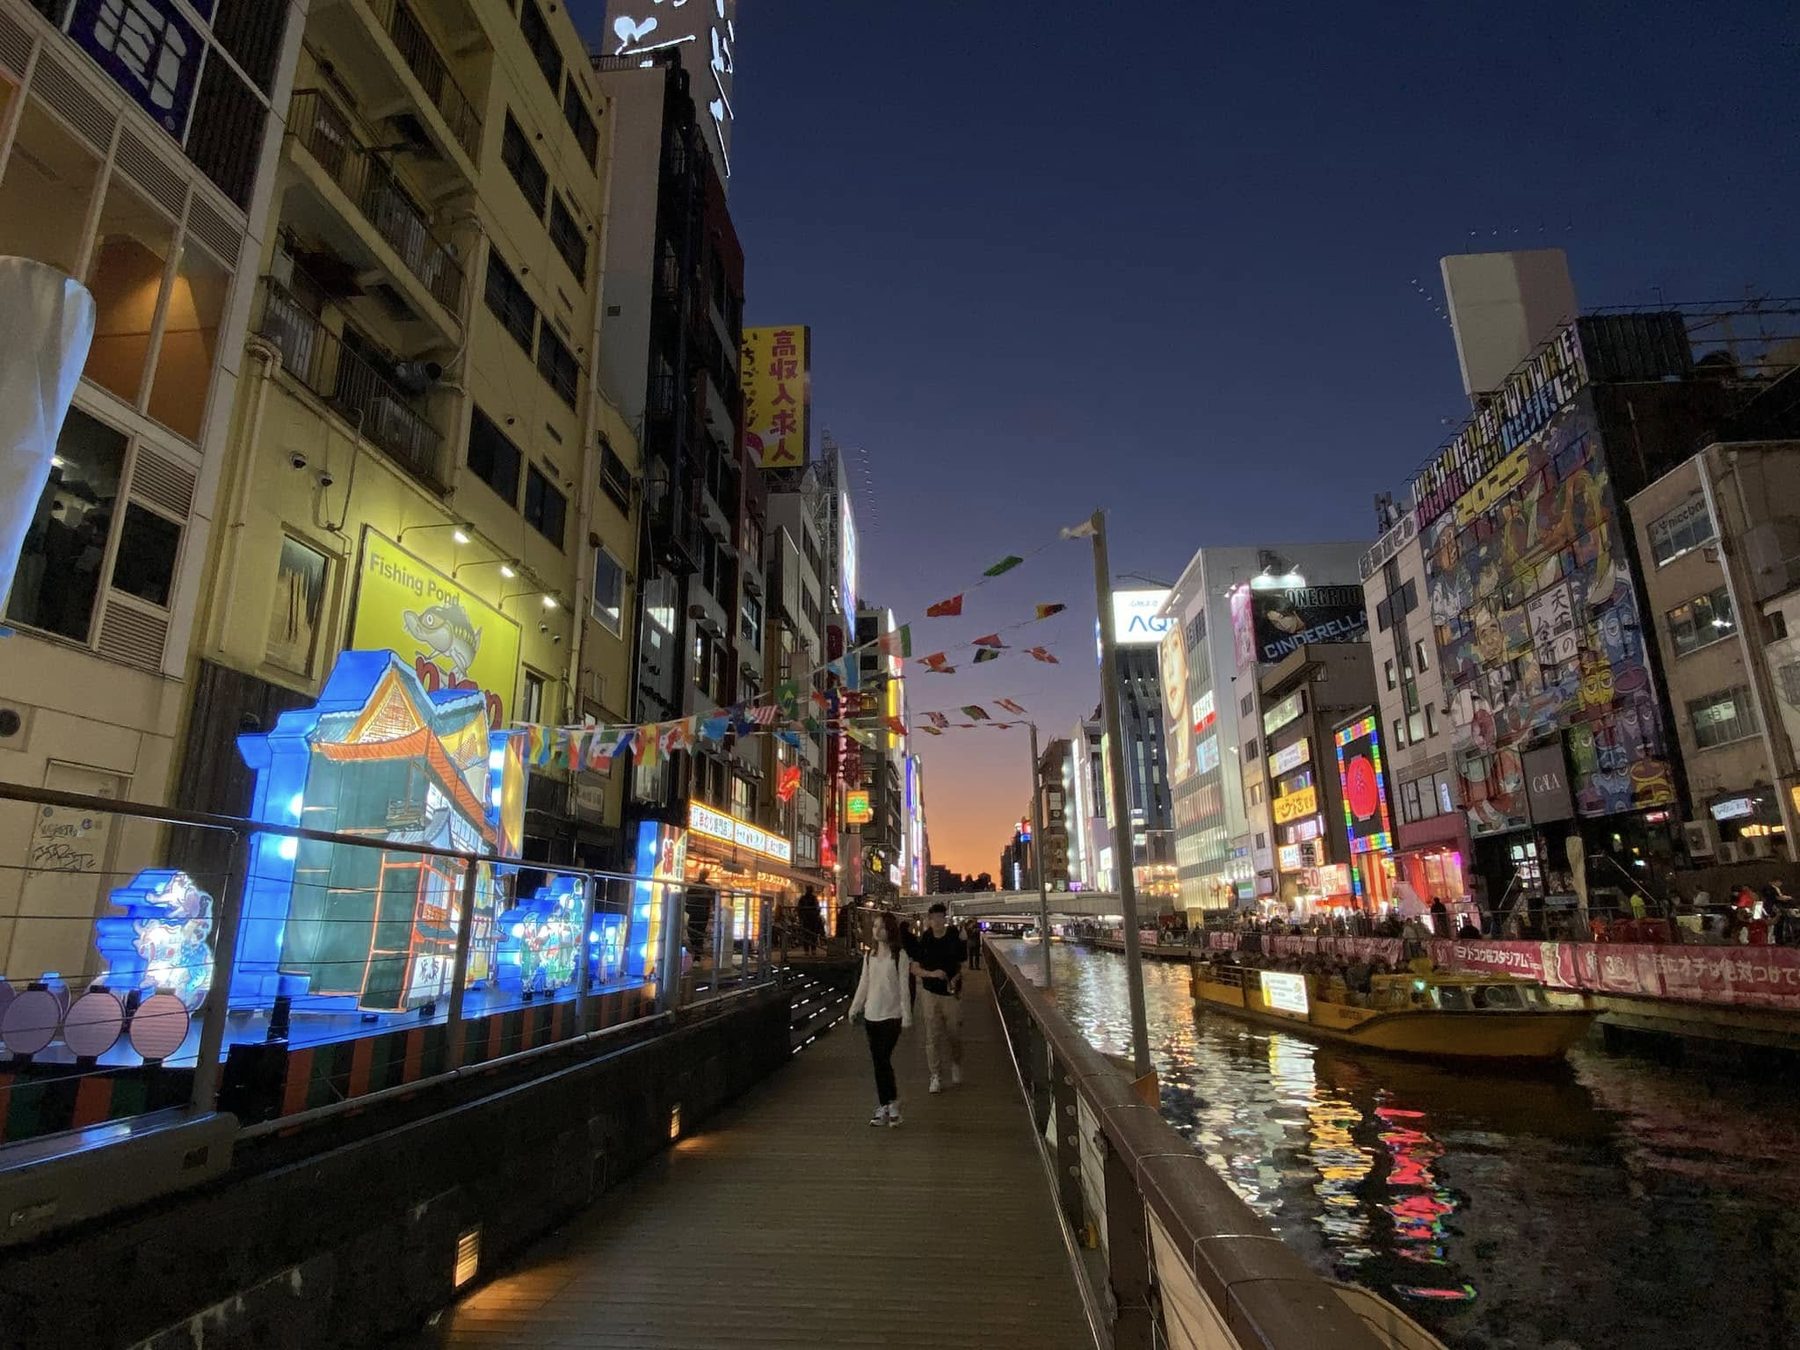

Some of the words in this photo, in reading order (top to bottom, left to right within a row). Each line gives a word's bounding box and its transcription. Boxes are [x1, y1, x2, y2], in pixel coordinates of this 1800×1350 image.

[1456, 444, 1532, 525] 2025
[369, 552, 424, 597] Fishing
[427, 580, 461, 608] Pond
[1263, 609, 1367, 659] CINDERELLA
